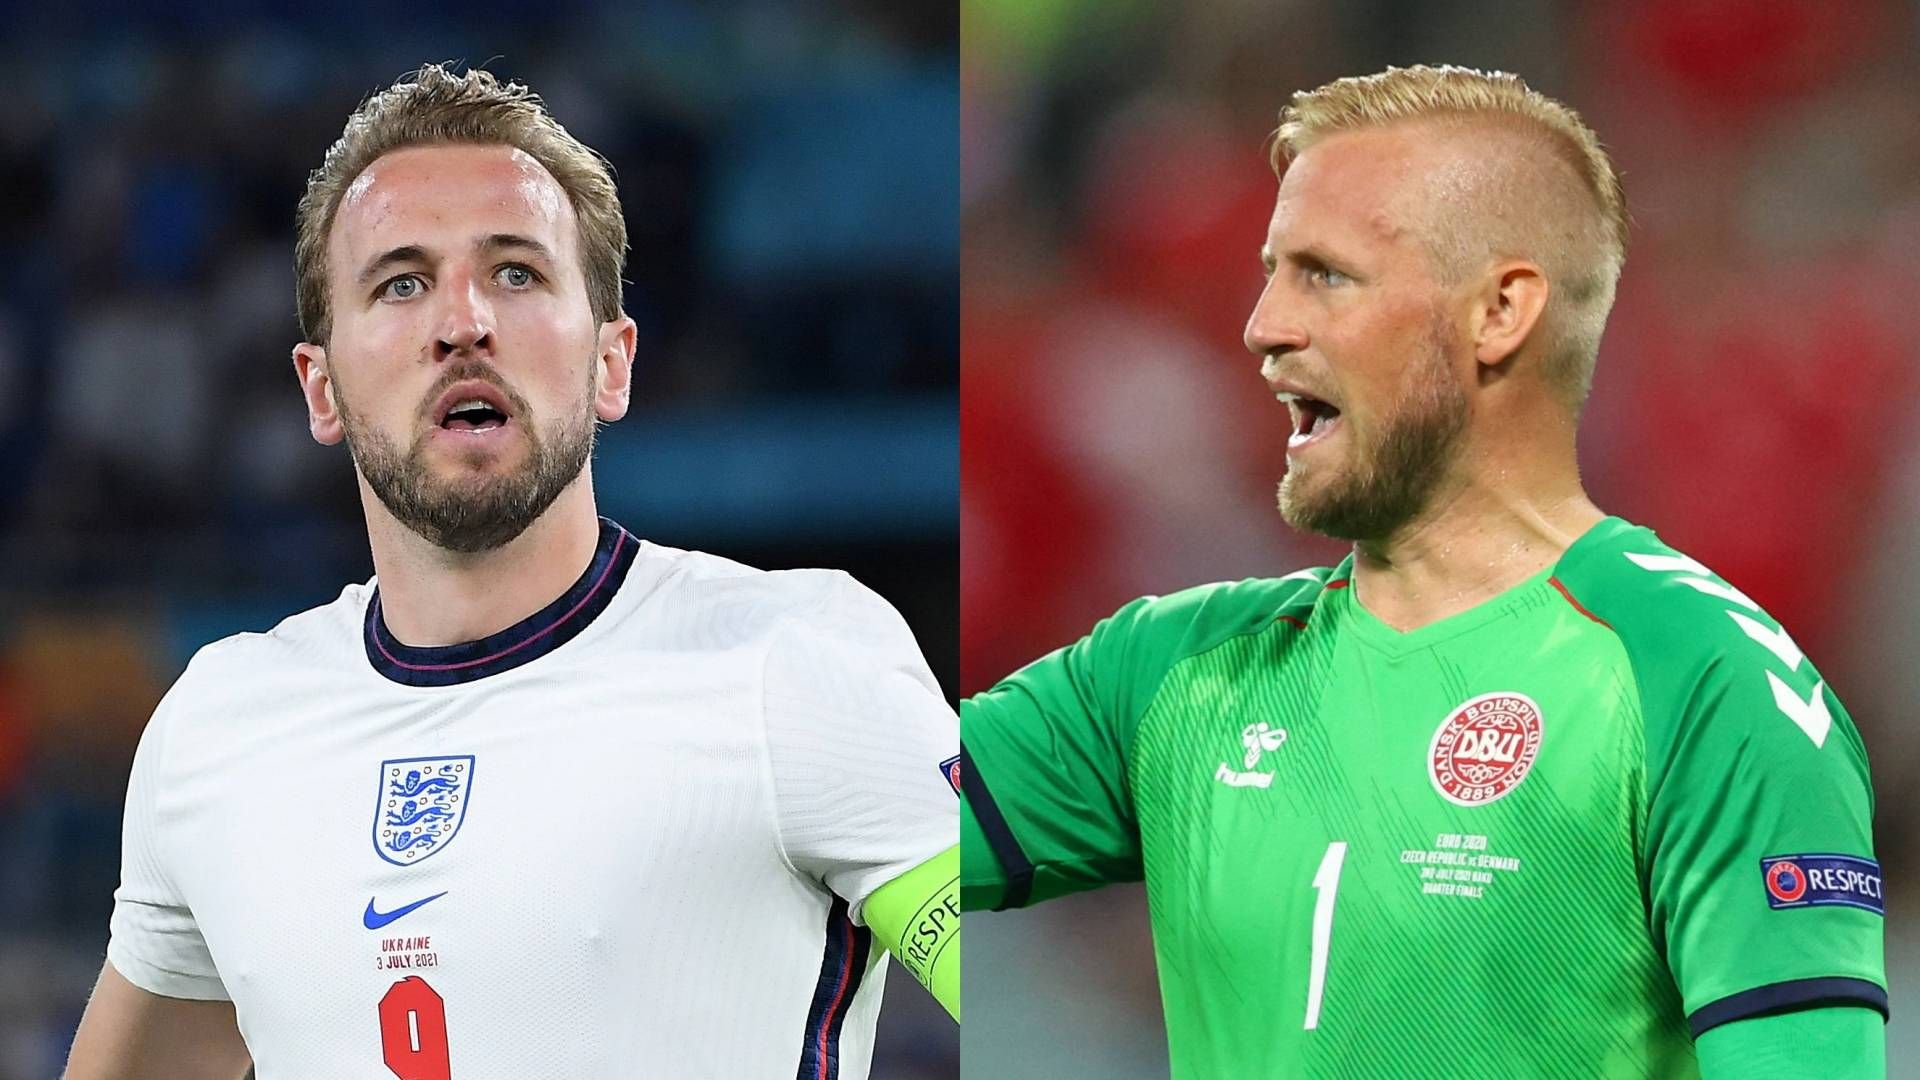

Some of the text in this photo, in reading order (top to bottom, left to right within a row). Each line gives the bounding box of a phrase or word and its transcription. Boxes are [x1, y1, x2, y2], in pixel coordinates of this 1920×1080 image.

[1436, 718, 1463, 786] DANSK
[1502, 730, 1539, 789] UNION
[1453, 729, 1523, 762] DBU
[1451, 784, 1496, 801] 1889
[1400, 850, 1426, 864] CZECH
[1426, 851, 1468, 866] REPUBLIC
[1478, 854, 1520, 872] DENMARK
[1808, 868, 1881, 899] RESPECT
[381, 936, 431, 953] UKRAINE
[1303, 841, 1349, 1030] 1
[376, 952, 439, 970] 3 JULY 2021
[378, 975, 452, 1080] 9
